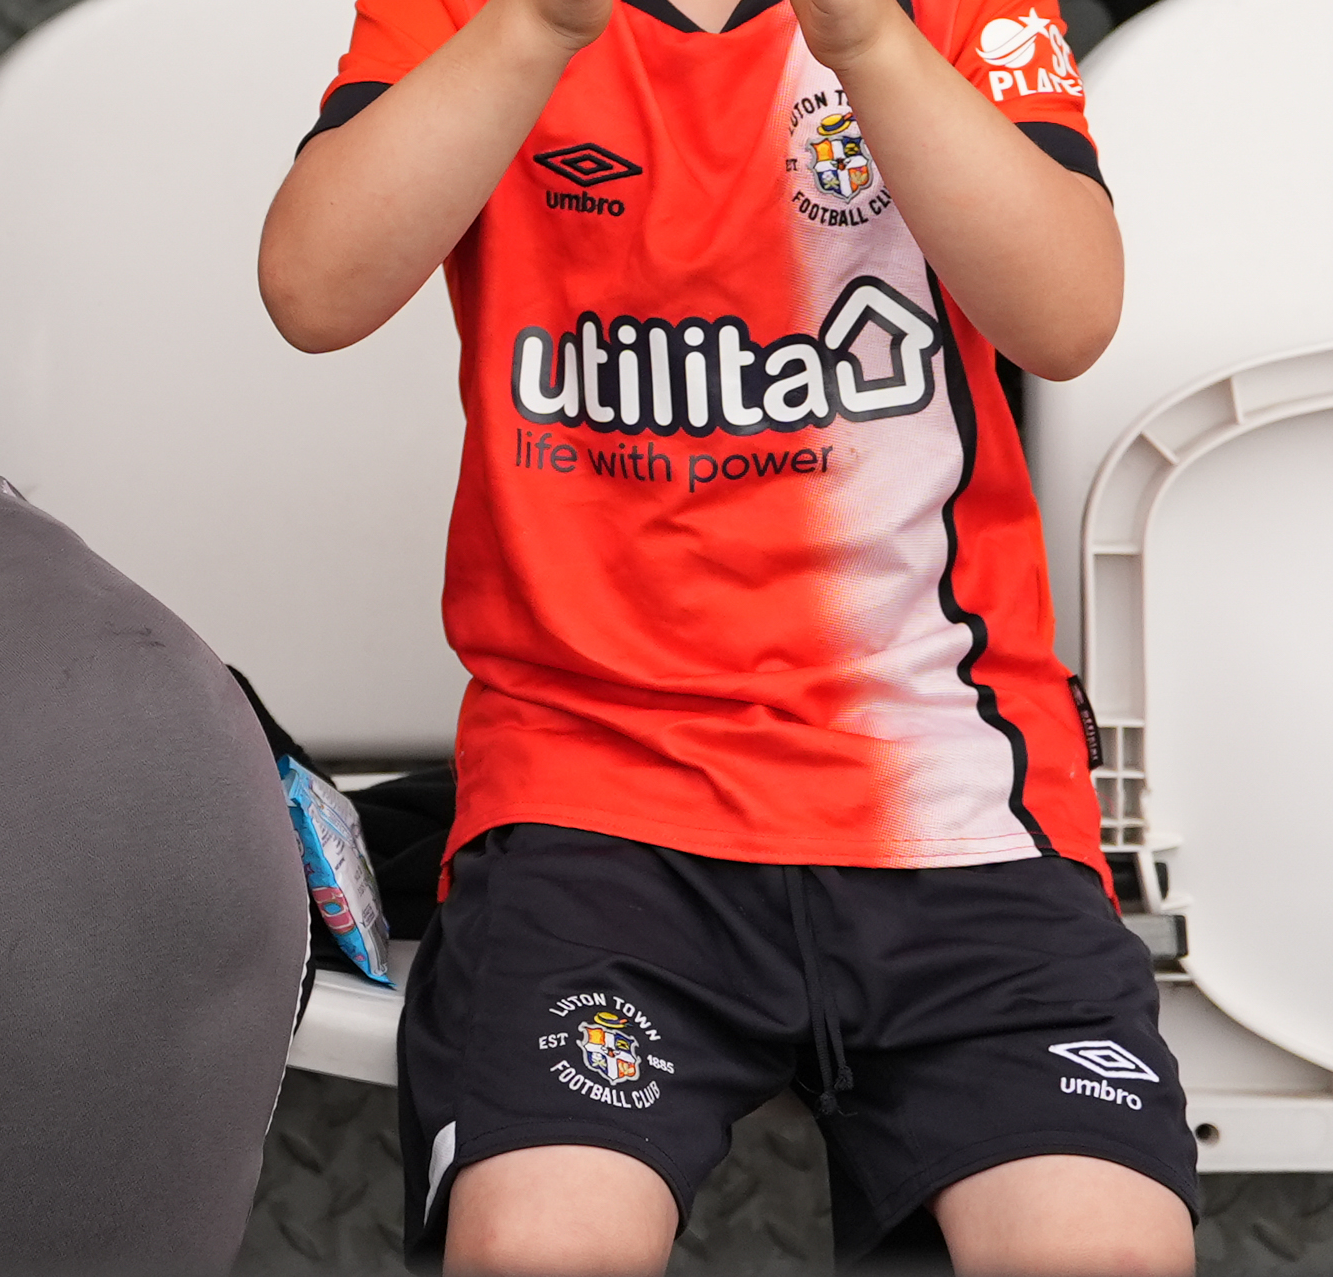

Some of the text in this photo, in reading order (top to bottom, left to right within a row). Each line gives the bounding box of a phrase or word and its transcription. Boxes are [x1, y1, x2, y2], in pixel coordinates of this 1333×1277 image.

[545, 190, 625, 217] umbro
[791, 190, 869, 227] FOOTBALL
[518, 320, 830, 428] utilita
[515, 428, 834, 493] life with power
[548, 992, 661, 1041] LUTON TOWN
[538, 1032, 569, 1050] EST
[646, 1054, 675, 1074] 1885
[549, 1059, 661, 1109] FOOTBALL CLUB
[1059, 1074, 1143, 1111] umbro
